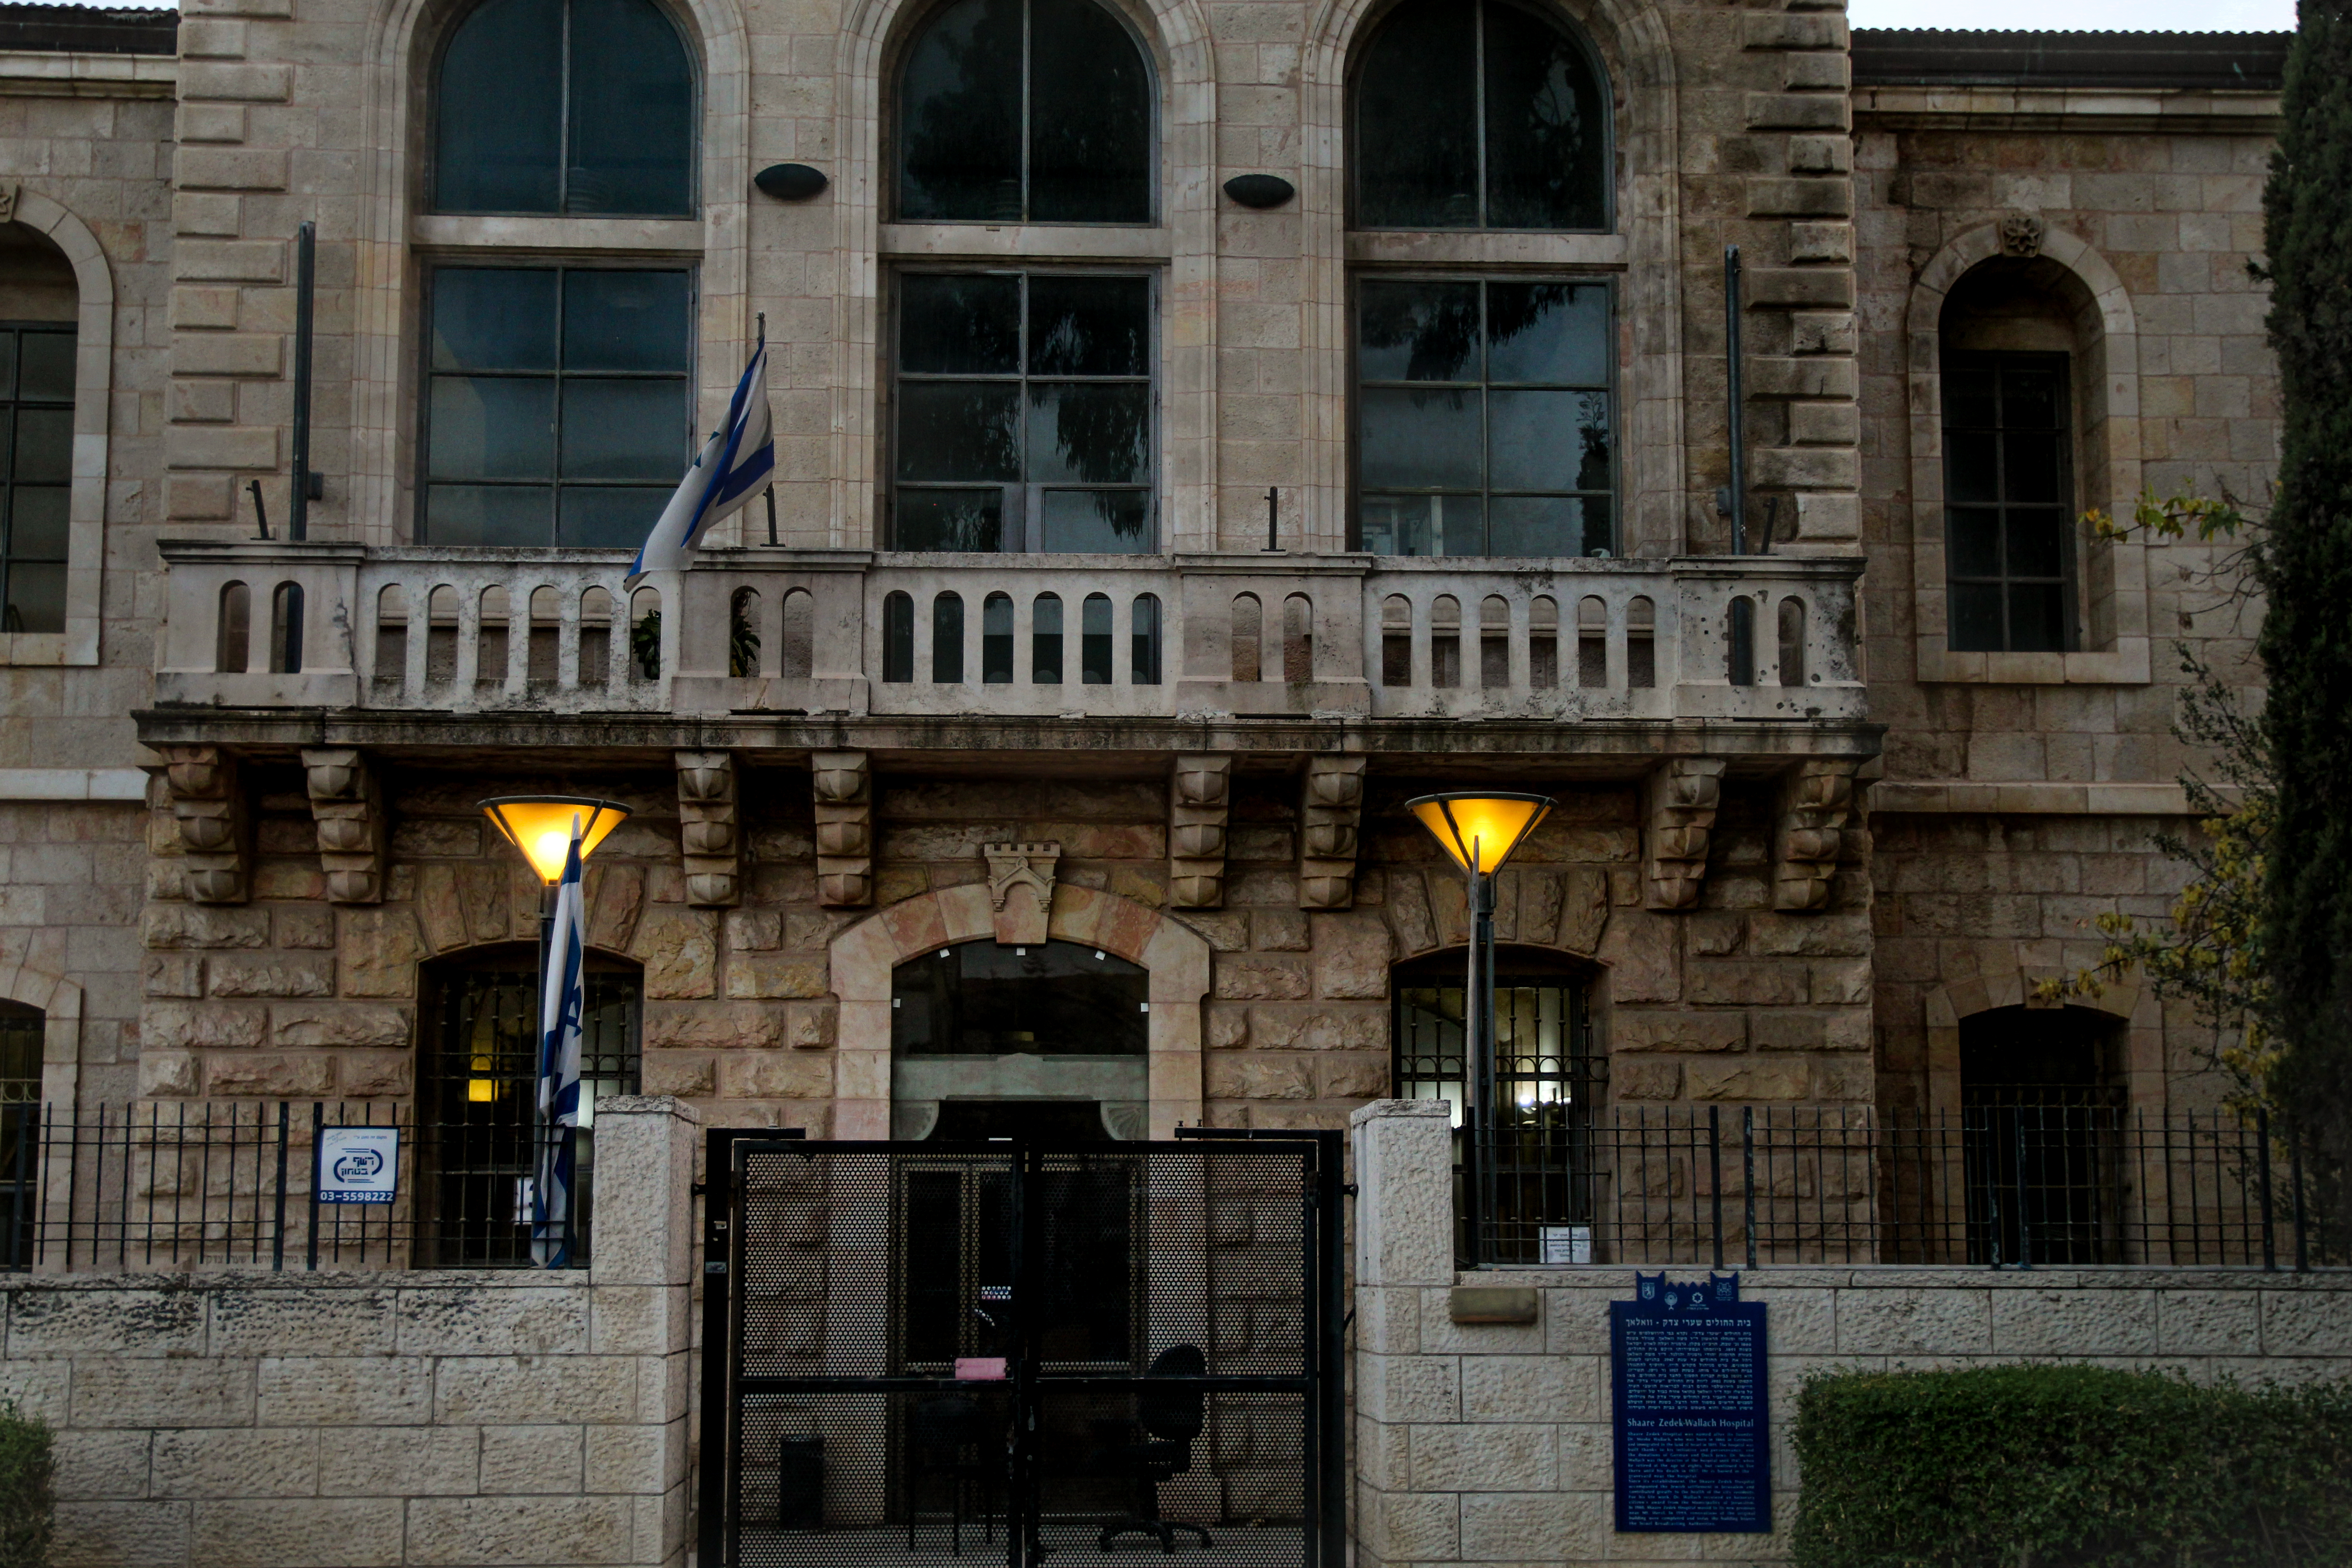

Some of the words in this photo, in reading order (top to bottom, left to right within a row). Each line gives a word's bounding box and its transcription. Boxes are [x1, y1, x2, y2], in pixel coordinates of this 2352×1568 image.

[320, 1192, 393, 1201] 03-5598222
[1626, 1317, 1653, 1327] וואלאך
[1663, 1318, 1679, 1327] צדק
[1682, 1318, 1703, 1327] שערי
[1706, 1318, 1734, 1327] החולים
[1627, 1418, 1655, 1427] Shaare
[1659, 1418, 1717, 1427] Zedek-Wallach
[1720, 1419, 1754, 1429] Hospital
